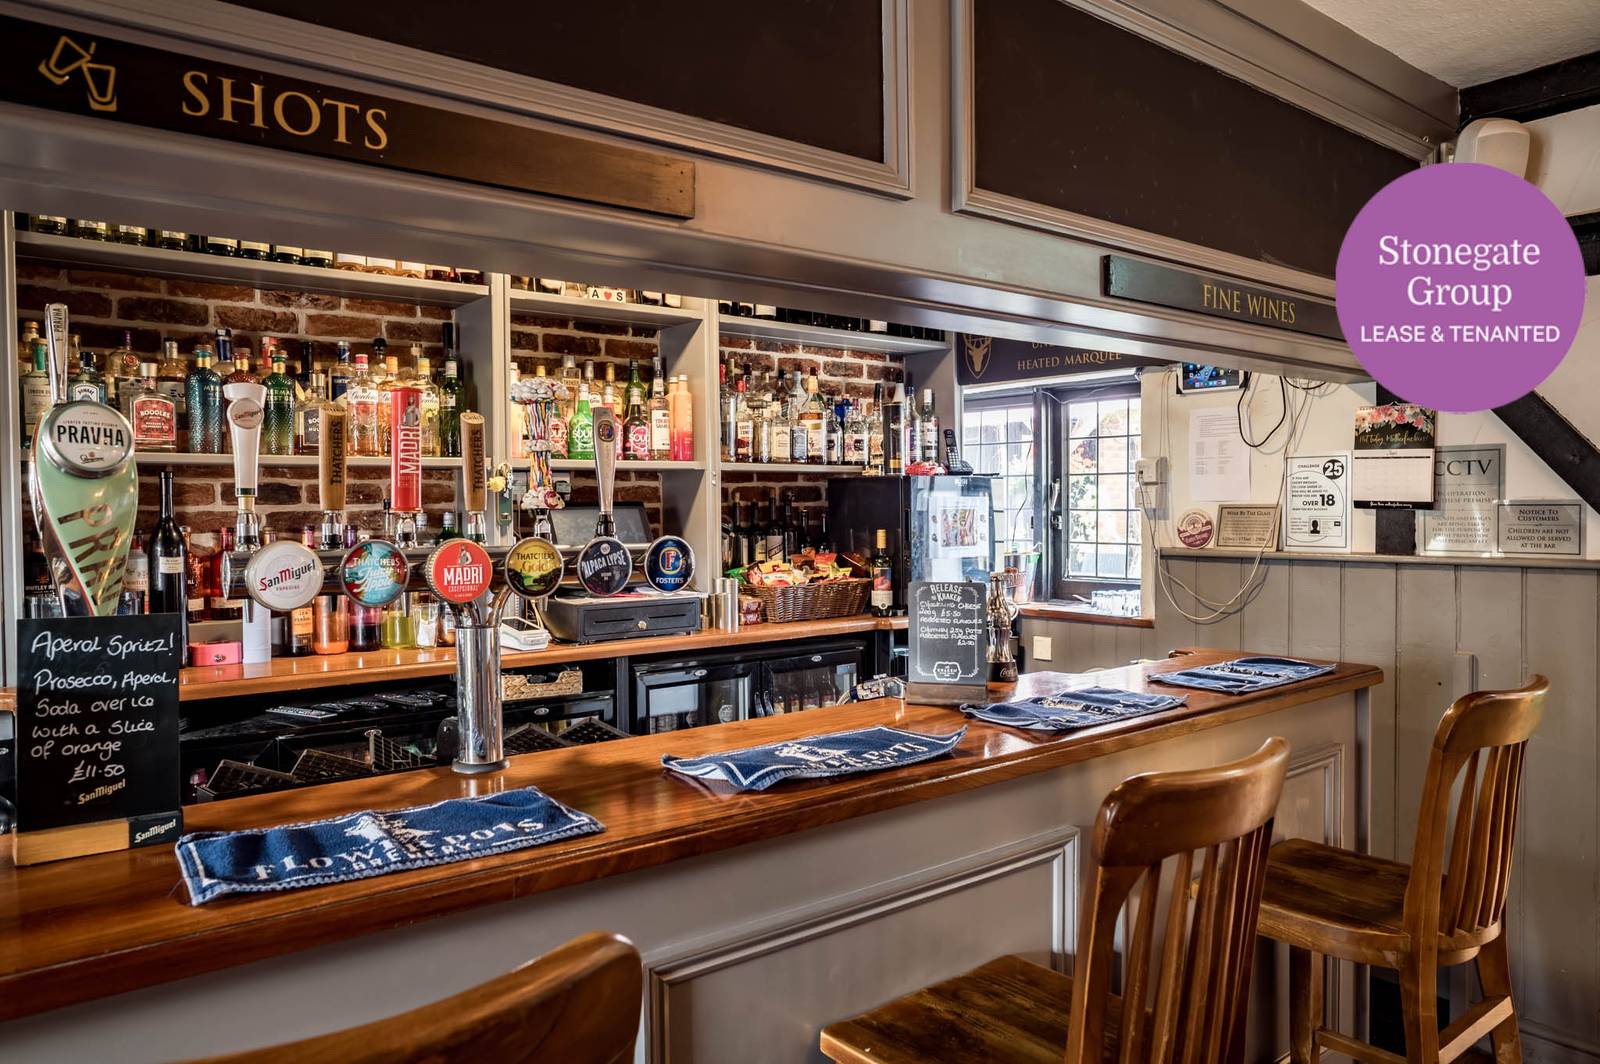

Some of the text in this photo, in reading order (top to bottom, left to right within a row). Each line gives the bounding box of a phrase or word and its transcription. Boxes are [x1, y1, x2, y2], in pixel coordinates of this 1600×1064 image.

[182, 71, 389, 151] SHOTS
[1202, 284, 1296, 324] FINE WINES
[53, 308, 64, 332] PRAVHA
[1017, 350, 1123, 371] HEATED MARQUEE
[57, 424, 124, 447] PRAVHA
[330, 420, 343, 486] THATCHERS
[474, 429, 484, 492] THATCHERS
[1324, 462, 1343, 477] 25
[1434, 459, 1492, 477] CCTV
[1319, 494, 1336, 506] 18
[517, 552, 556, 561] THATCHERS
[258, 558, 316, 591] SanMiguel
[930, 584, 963, 595] RELEASE
[31, 631, 175, 661] Aperol Spritz!
[33, 668, 118, 695] Prosecco,
[34, 696, 154, 718] Soda over ice
[32, 726, 81, 739] with
[86, 724, 100, 735] a
[31, 740, 122, 761] of orange
[78, 779, 127, 805] SanMiguel
[134, 818, 176, 844] SanMiguel
[442, 818, 545, 844] POTS
